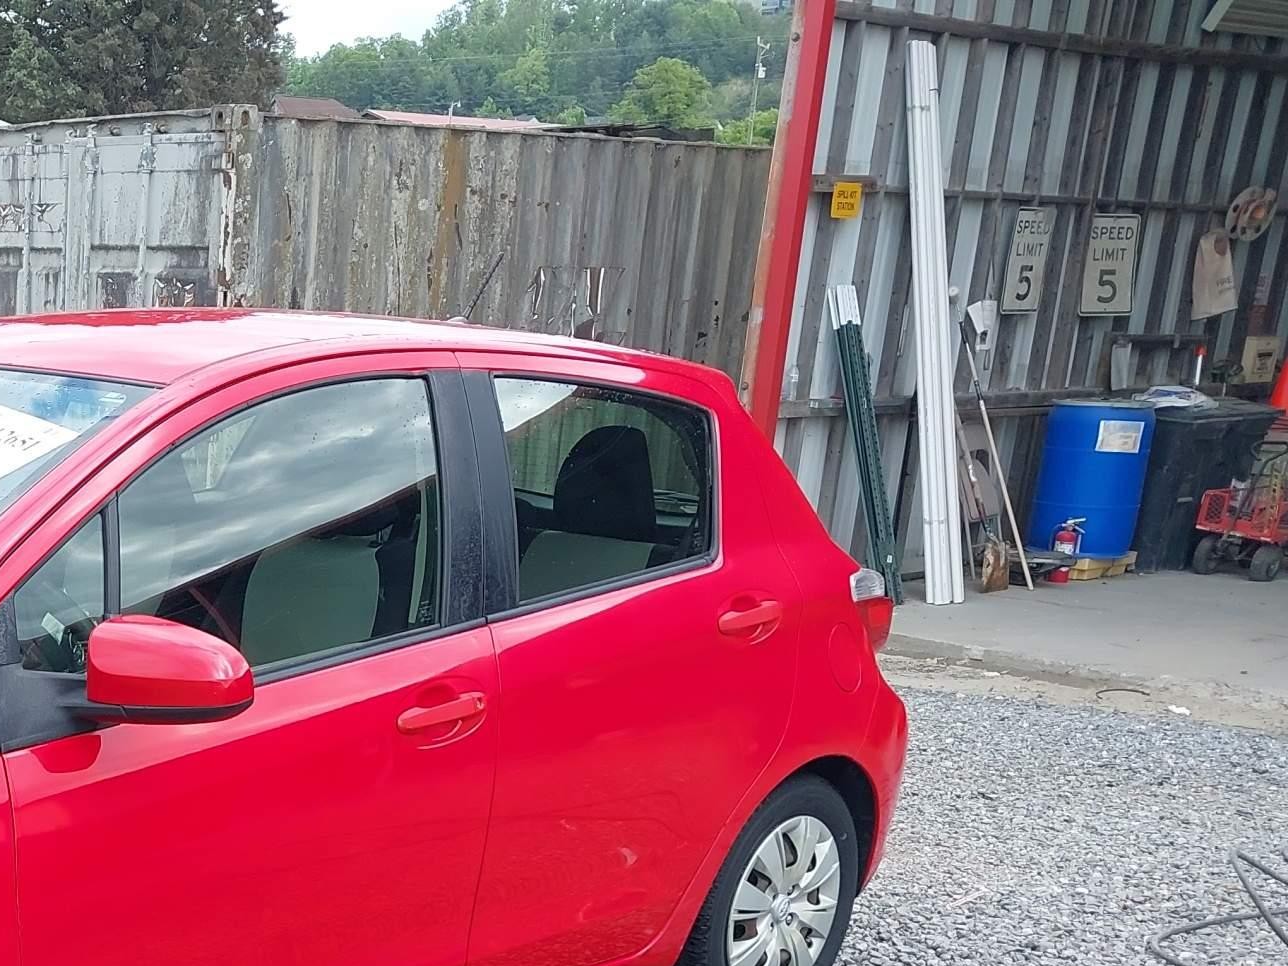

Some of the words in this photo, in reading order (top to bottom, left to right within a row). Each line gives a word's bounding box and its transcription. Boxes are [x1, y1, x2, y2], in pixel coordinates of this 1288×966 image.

[1016, 220, 1050, 236] SPEED
[1091, 226, 1134, 241] SPEED
[1015, 242, 1044, 257] LIMIT
[1092, 247, 1127, 262] LIMIT
[1015, 264, 1033, 301] 5
[1096, 268, 1117, 304] 5
